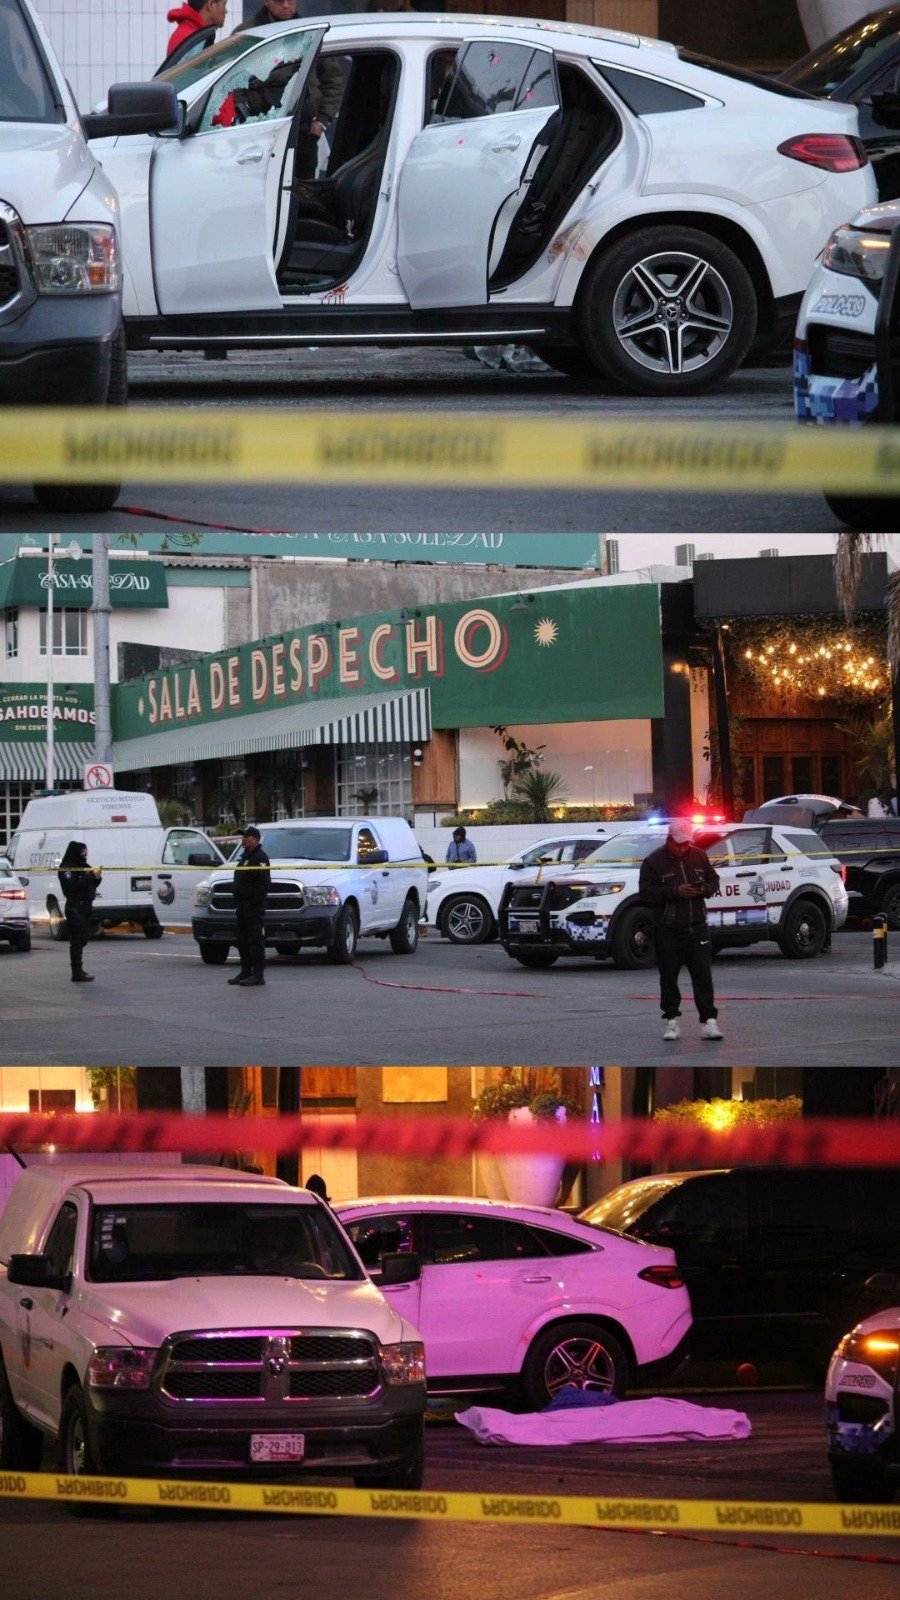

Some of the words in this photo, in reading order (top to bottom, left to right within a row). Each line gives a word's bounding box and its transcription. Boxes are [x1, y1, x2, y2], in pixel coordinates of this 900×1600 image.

[149, 669, 202, 724] SALA
[210, 656, 241, 710] DE
[251, 608, 504, 701] DESPECHO
[40, 694, 64, 702] PURTA
[725, 884, 741, 897] DE
